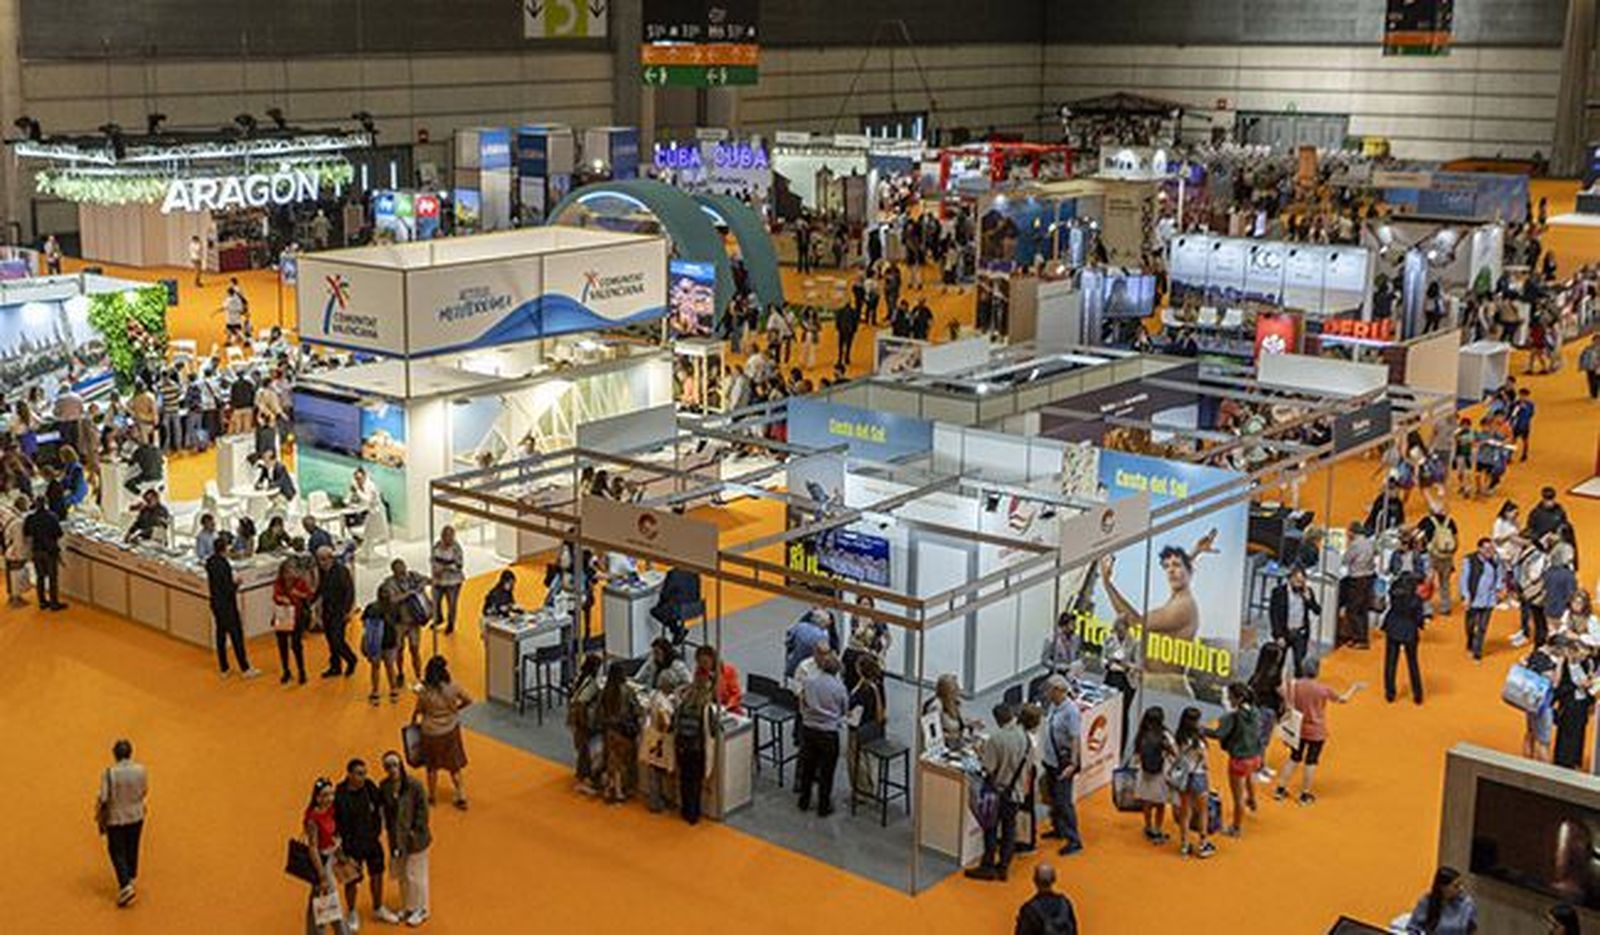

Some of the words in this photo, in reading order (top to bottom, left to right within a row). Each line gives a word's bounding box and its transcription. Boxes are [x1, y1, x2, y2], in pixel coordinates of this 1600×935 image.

[655, 146, 702, 169] CUBA
[714, 142, 769, 169] CUBA
[161, 163, 321, 214] ARAGÓN
[829, 418, 853, 435] Costa
[855, 422, 868, 440] del
[869, 423, 887, 443] Sol
[1115, 469, 1148, 490] Costa
[1151, 475, 1168, 495] del
[1170, 477, 1189, 499] Sol
[1147, 631, 1232, 677] nombre
